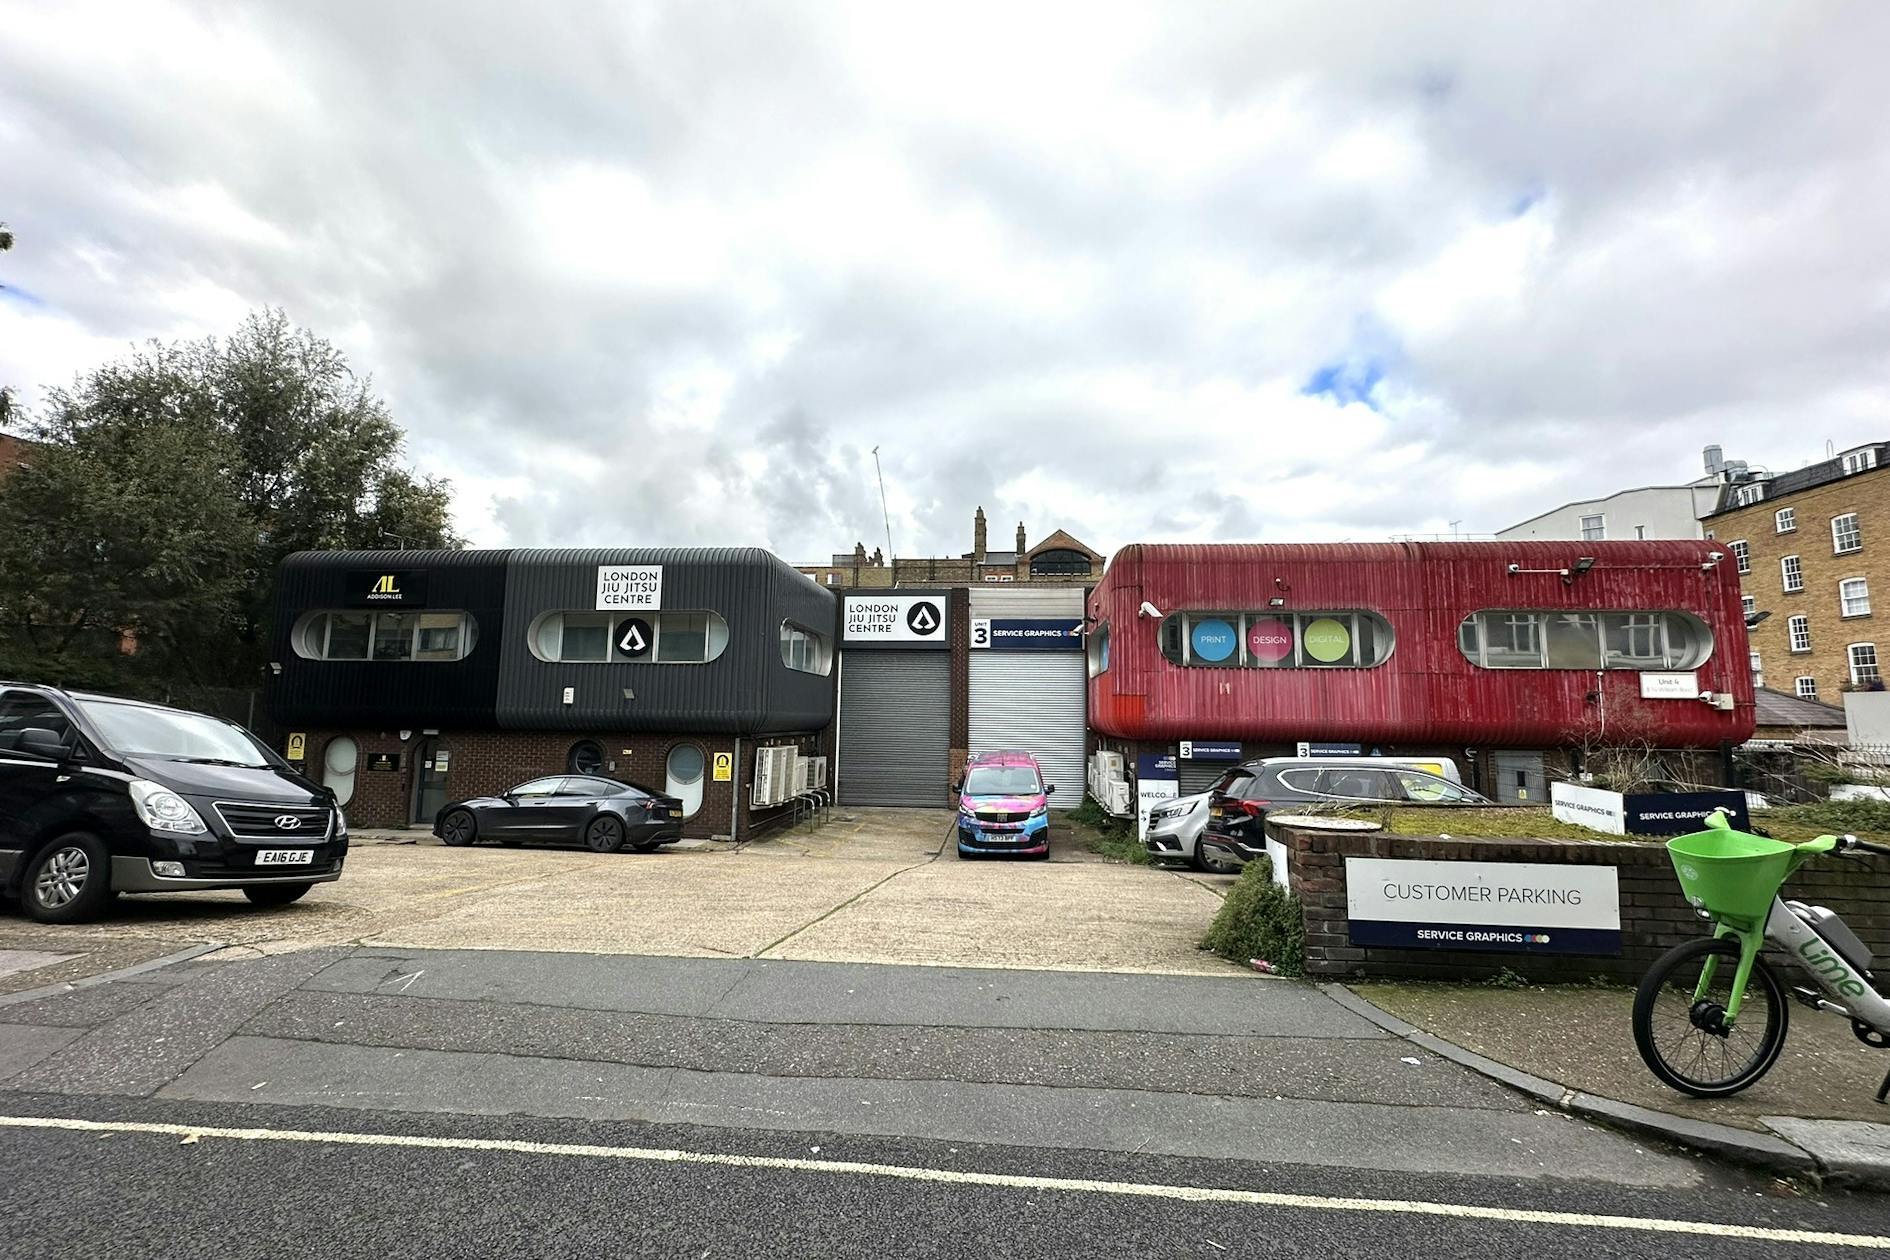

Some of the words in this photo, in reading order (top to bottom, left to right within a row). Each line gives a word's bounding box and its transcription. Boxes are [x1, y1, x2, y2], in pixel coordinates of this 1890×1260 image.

[604, 572, 657, 581] LONDON
[601, 582, 620, 594] JIU
[624, 582, 657, 594] JITSU
[604, 594, 652, 603] CENTRE
[849, 604, 898, 612] LONDON
[848, 614, 864, 623] JIU
[868, 614, 896, 623] JITSU
[848, 624, 892, 632] CENTRE
[974, 628, 987, 643] 3
[1253, 636, 1287, 644] DESIGN
[1309, 635, 1344, 643] DIGITAL
[1182, 747, 1190, 756] 3
[1300, 748, 1307, 757] 3
[1555, 800, 1575, 809] SERVICE
[1576, 803, 1604, 815] GRAPHICS
[1639, 812, 1674, 820] SERVICE
[1675, 811, 1713, 819] GRAPHIC
[263, 852, 288, 862] EA16
[289, 852, 308, 862] GJE
[1383, 883, 1492, 902] CUSTOMER
[1498, 887, 1581, 905] PARKING
[1417, 929, 1463, 941] SERVICE
[1466, 931, 1522, 943] GRAPHICS
[1799, 937, 1865, 997] Lime
